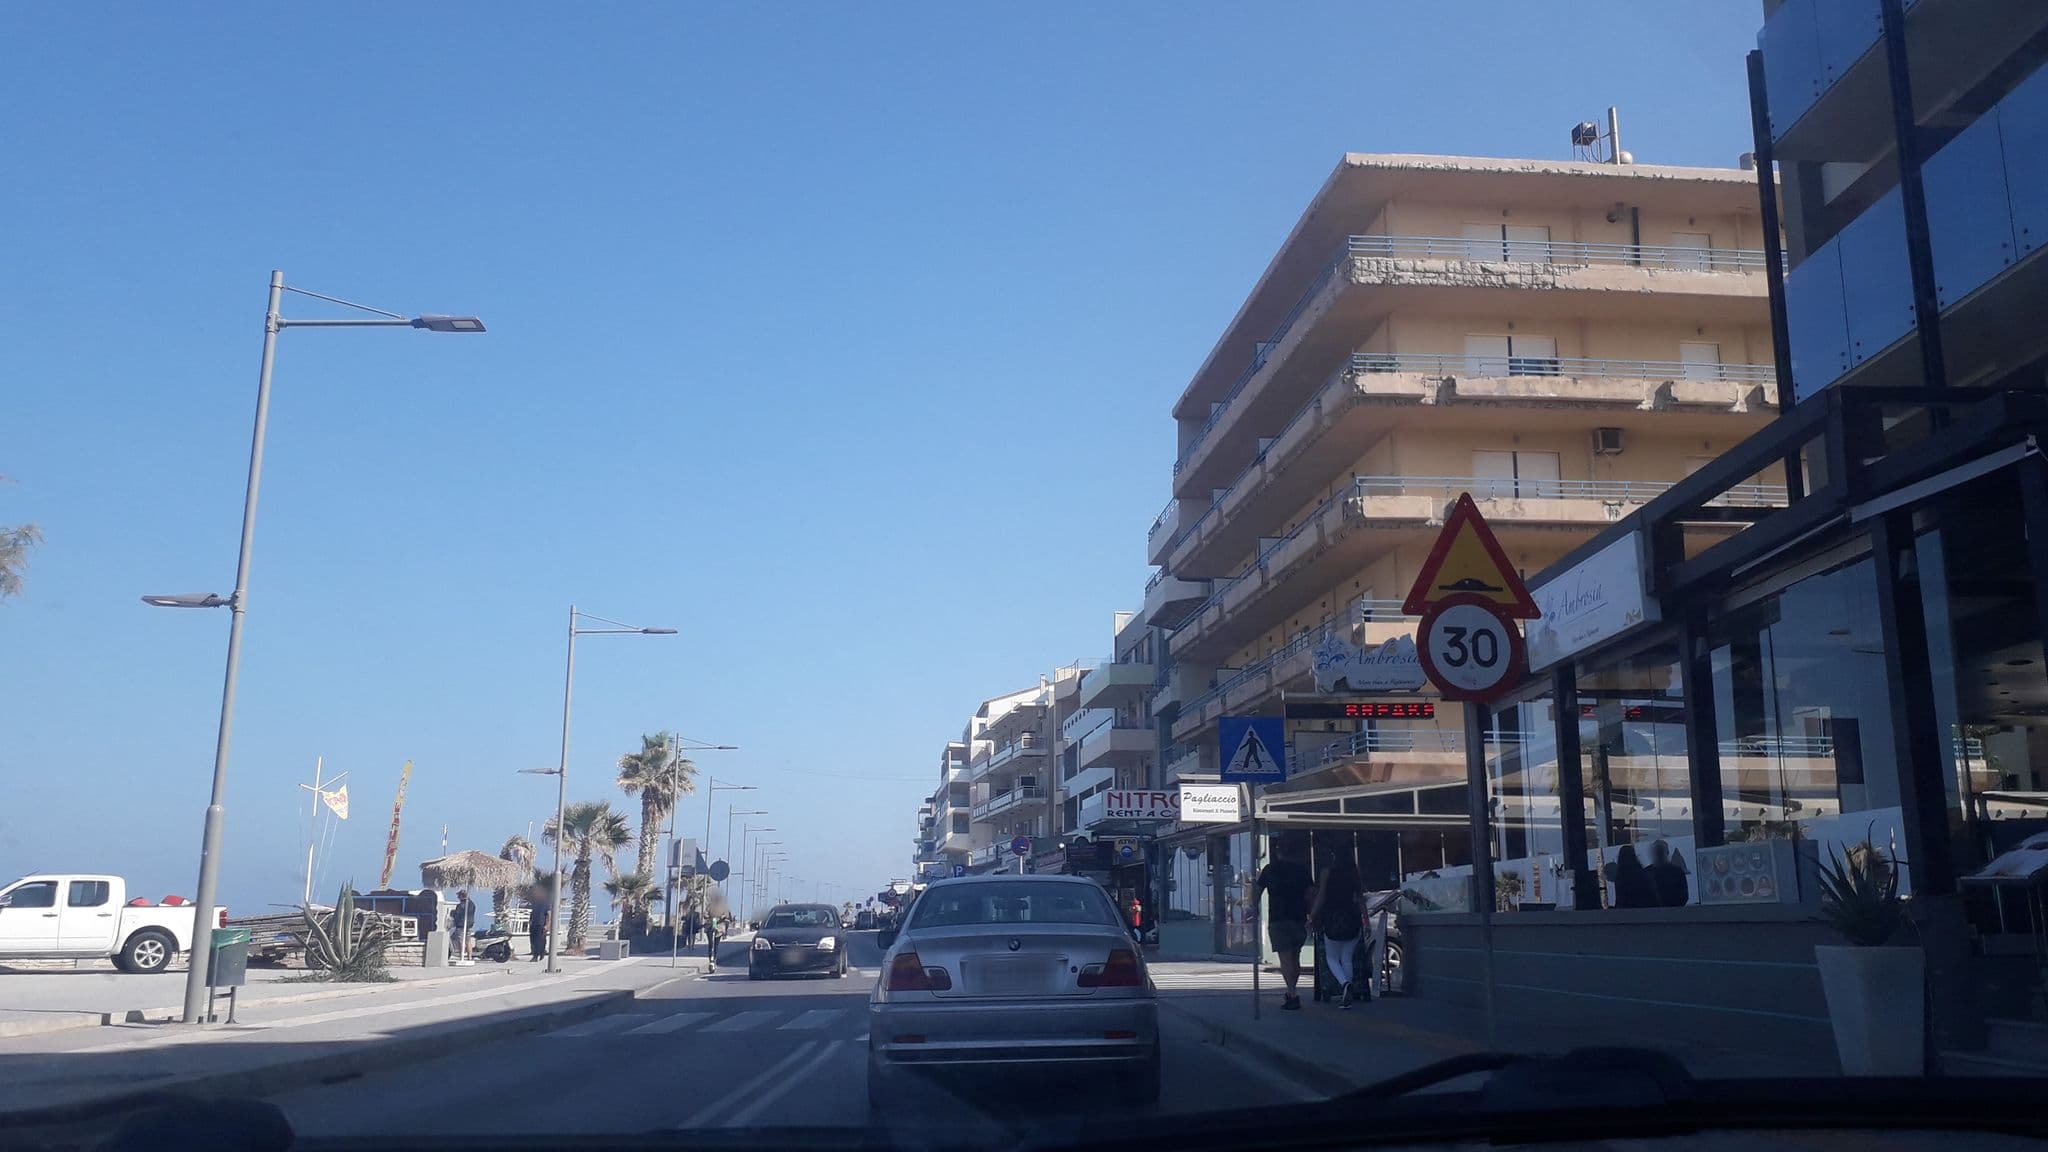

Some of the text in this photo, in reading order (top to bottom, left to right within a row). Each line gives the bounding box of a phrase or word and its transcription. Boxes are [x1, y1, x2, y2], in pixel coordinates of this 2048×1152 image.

[1442, 626, 1498, 668] 30
[1183, 792, 1237, 804] Pagliaccio
[1107, 809, 1178, 818] RENT A C
[956, 865, 964, 876] P
